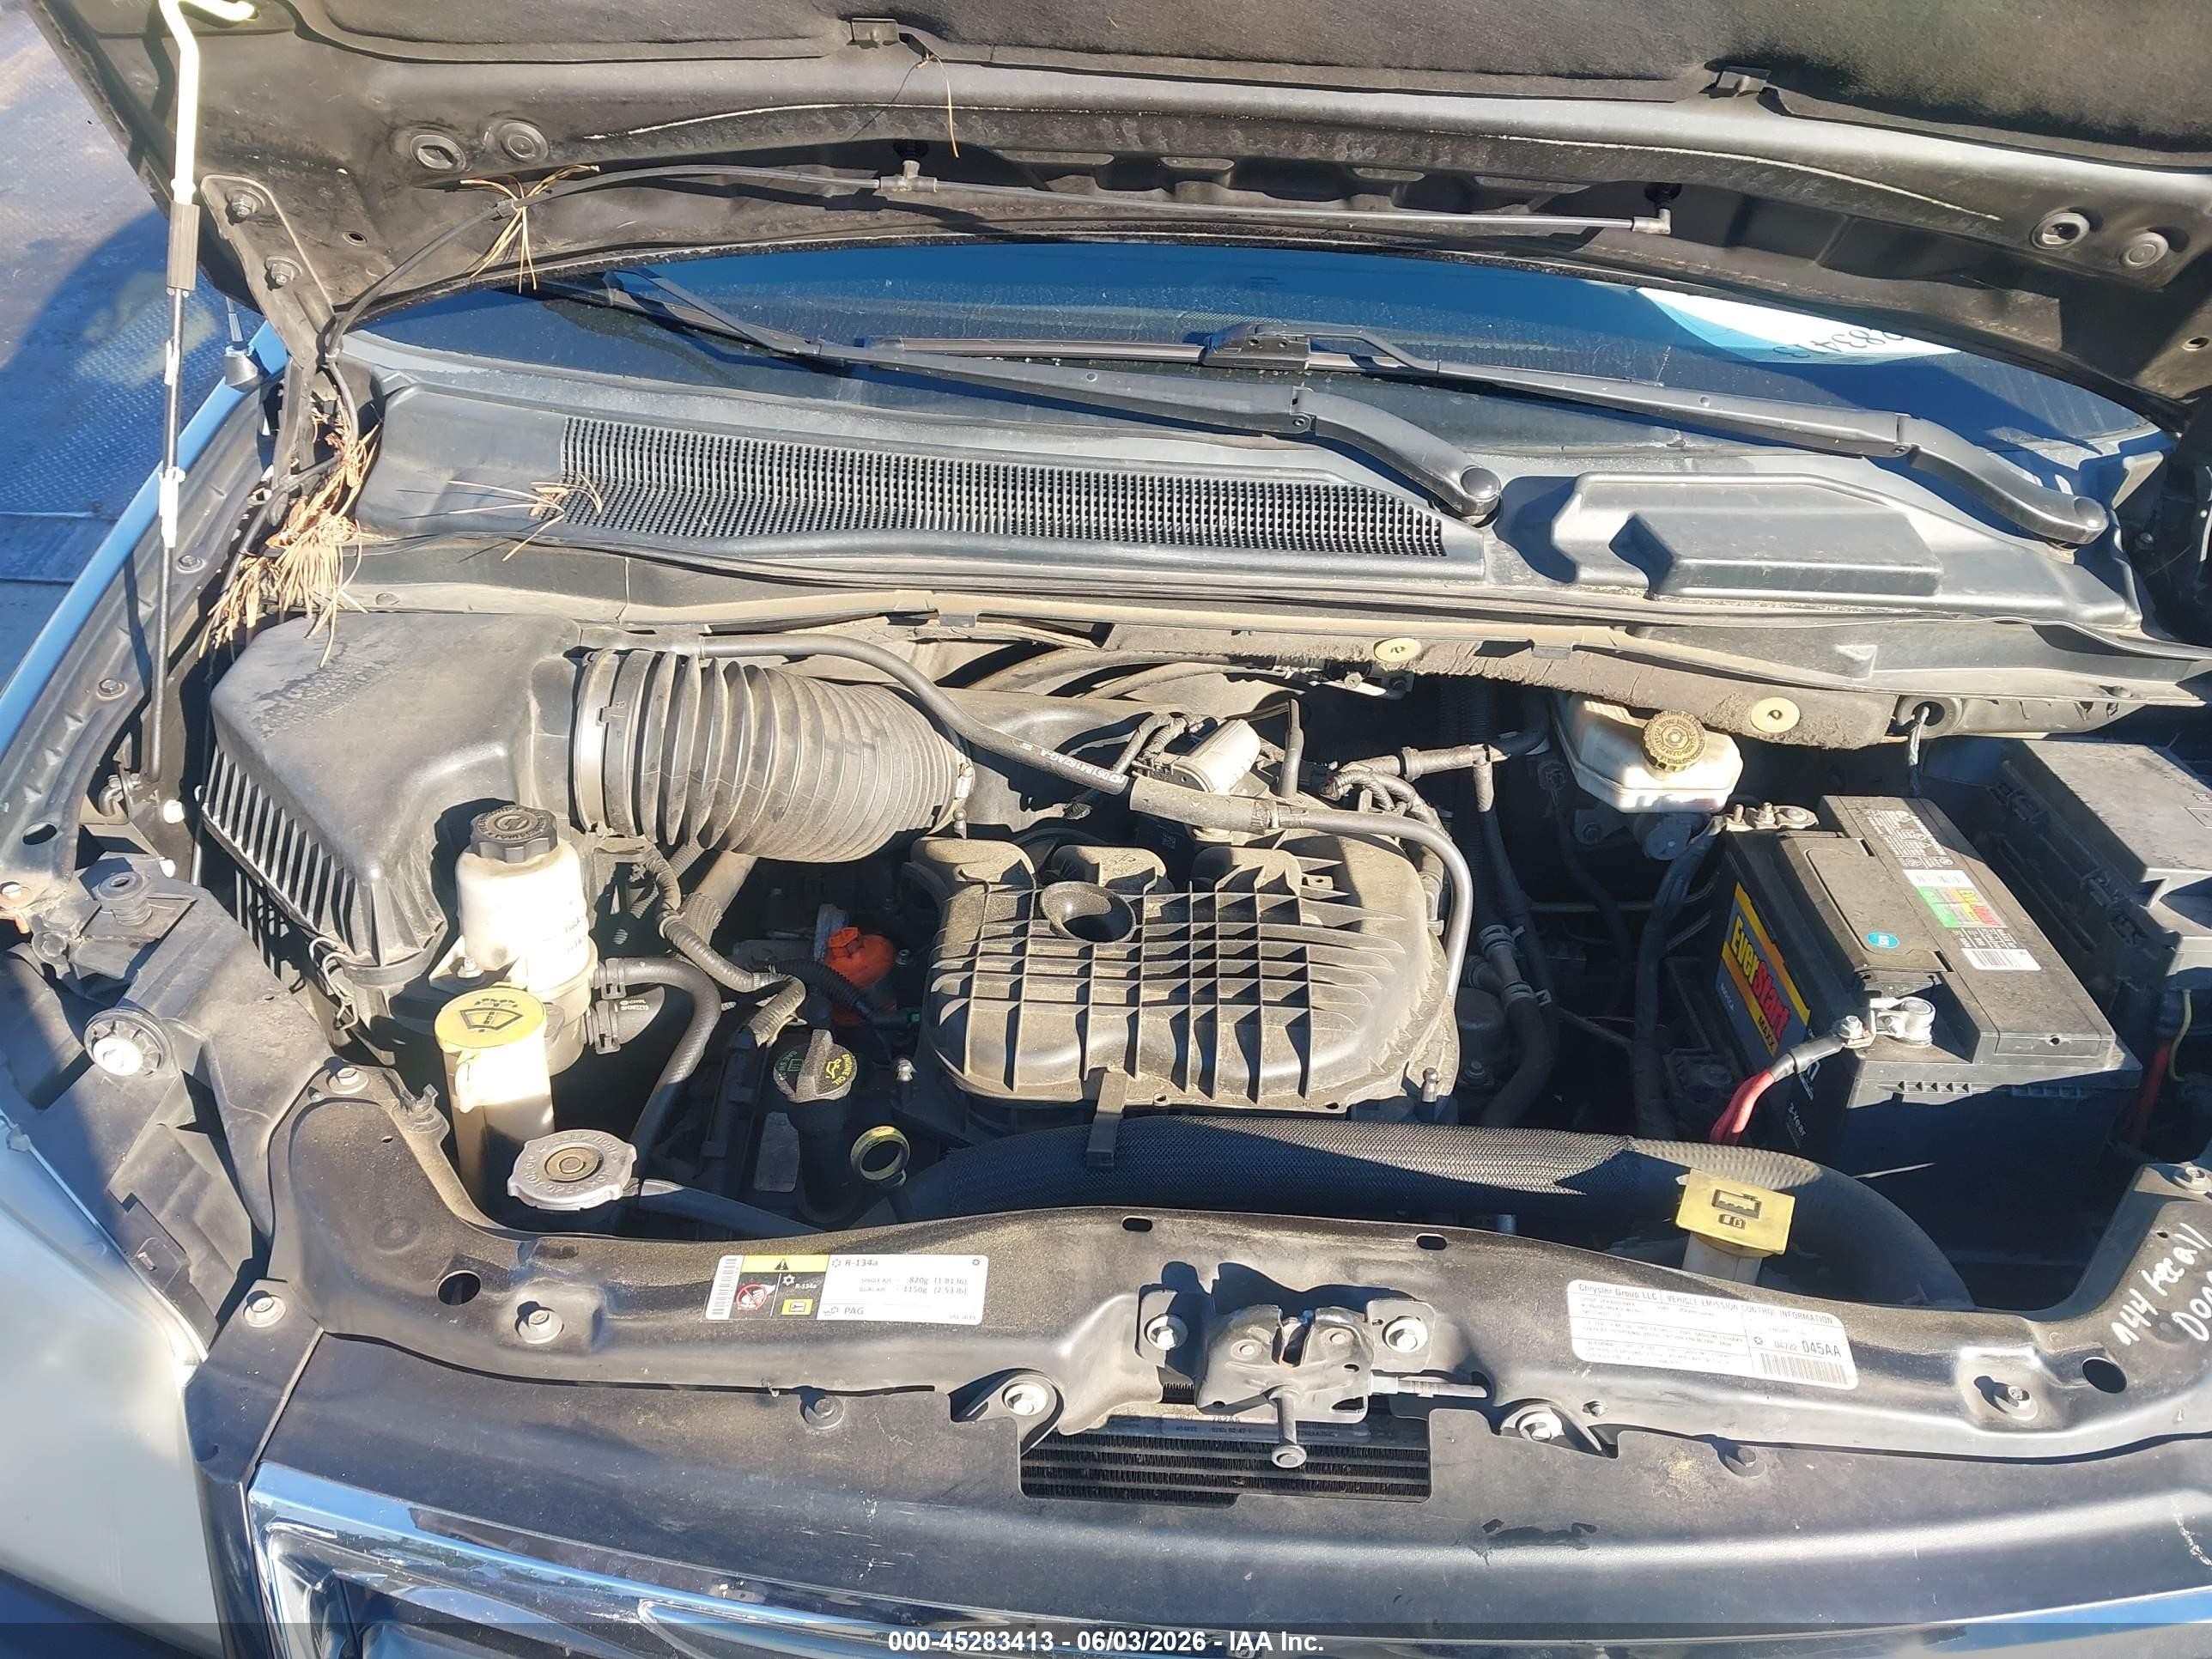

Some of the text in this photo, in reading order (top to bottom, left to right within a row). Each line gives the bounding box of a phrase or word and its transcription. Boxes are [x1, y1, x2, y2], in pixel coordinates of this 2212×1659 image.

[1758, 1016, 1775, 1052] MAXX
[831, 1054, 853, 1085] ENGINE OIL
[908, 1277, 928, 1285] 820g
[1579, 1284, 1612, 1295] Chrysler
[1615, 1288, 1639, 1299] Group
[1642, 1291, 1657, 1300] LLC
[1667, 1295, 1697, 1305] VEHICLE
[1701, 1299, 1739, 1312] EMISSION
[1741, 1304, 1775, 1316] CONTROL
[1779, 1310, 1833, 1325] INFORMATION
